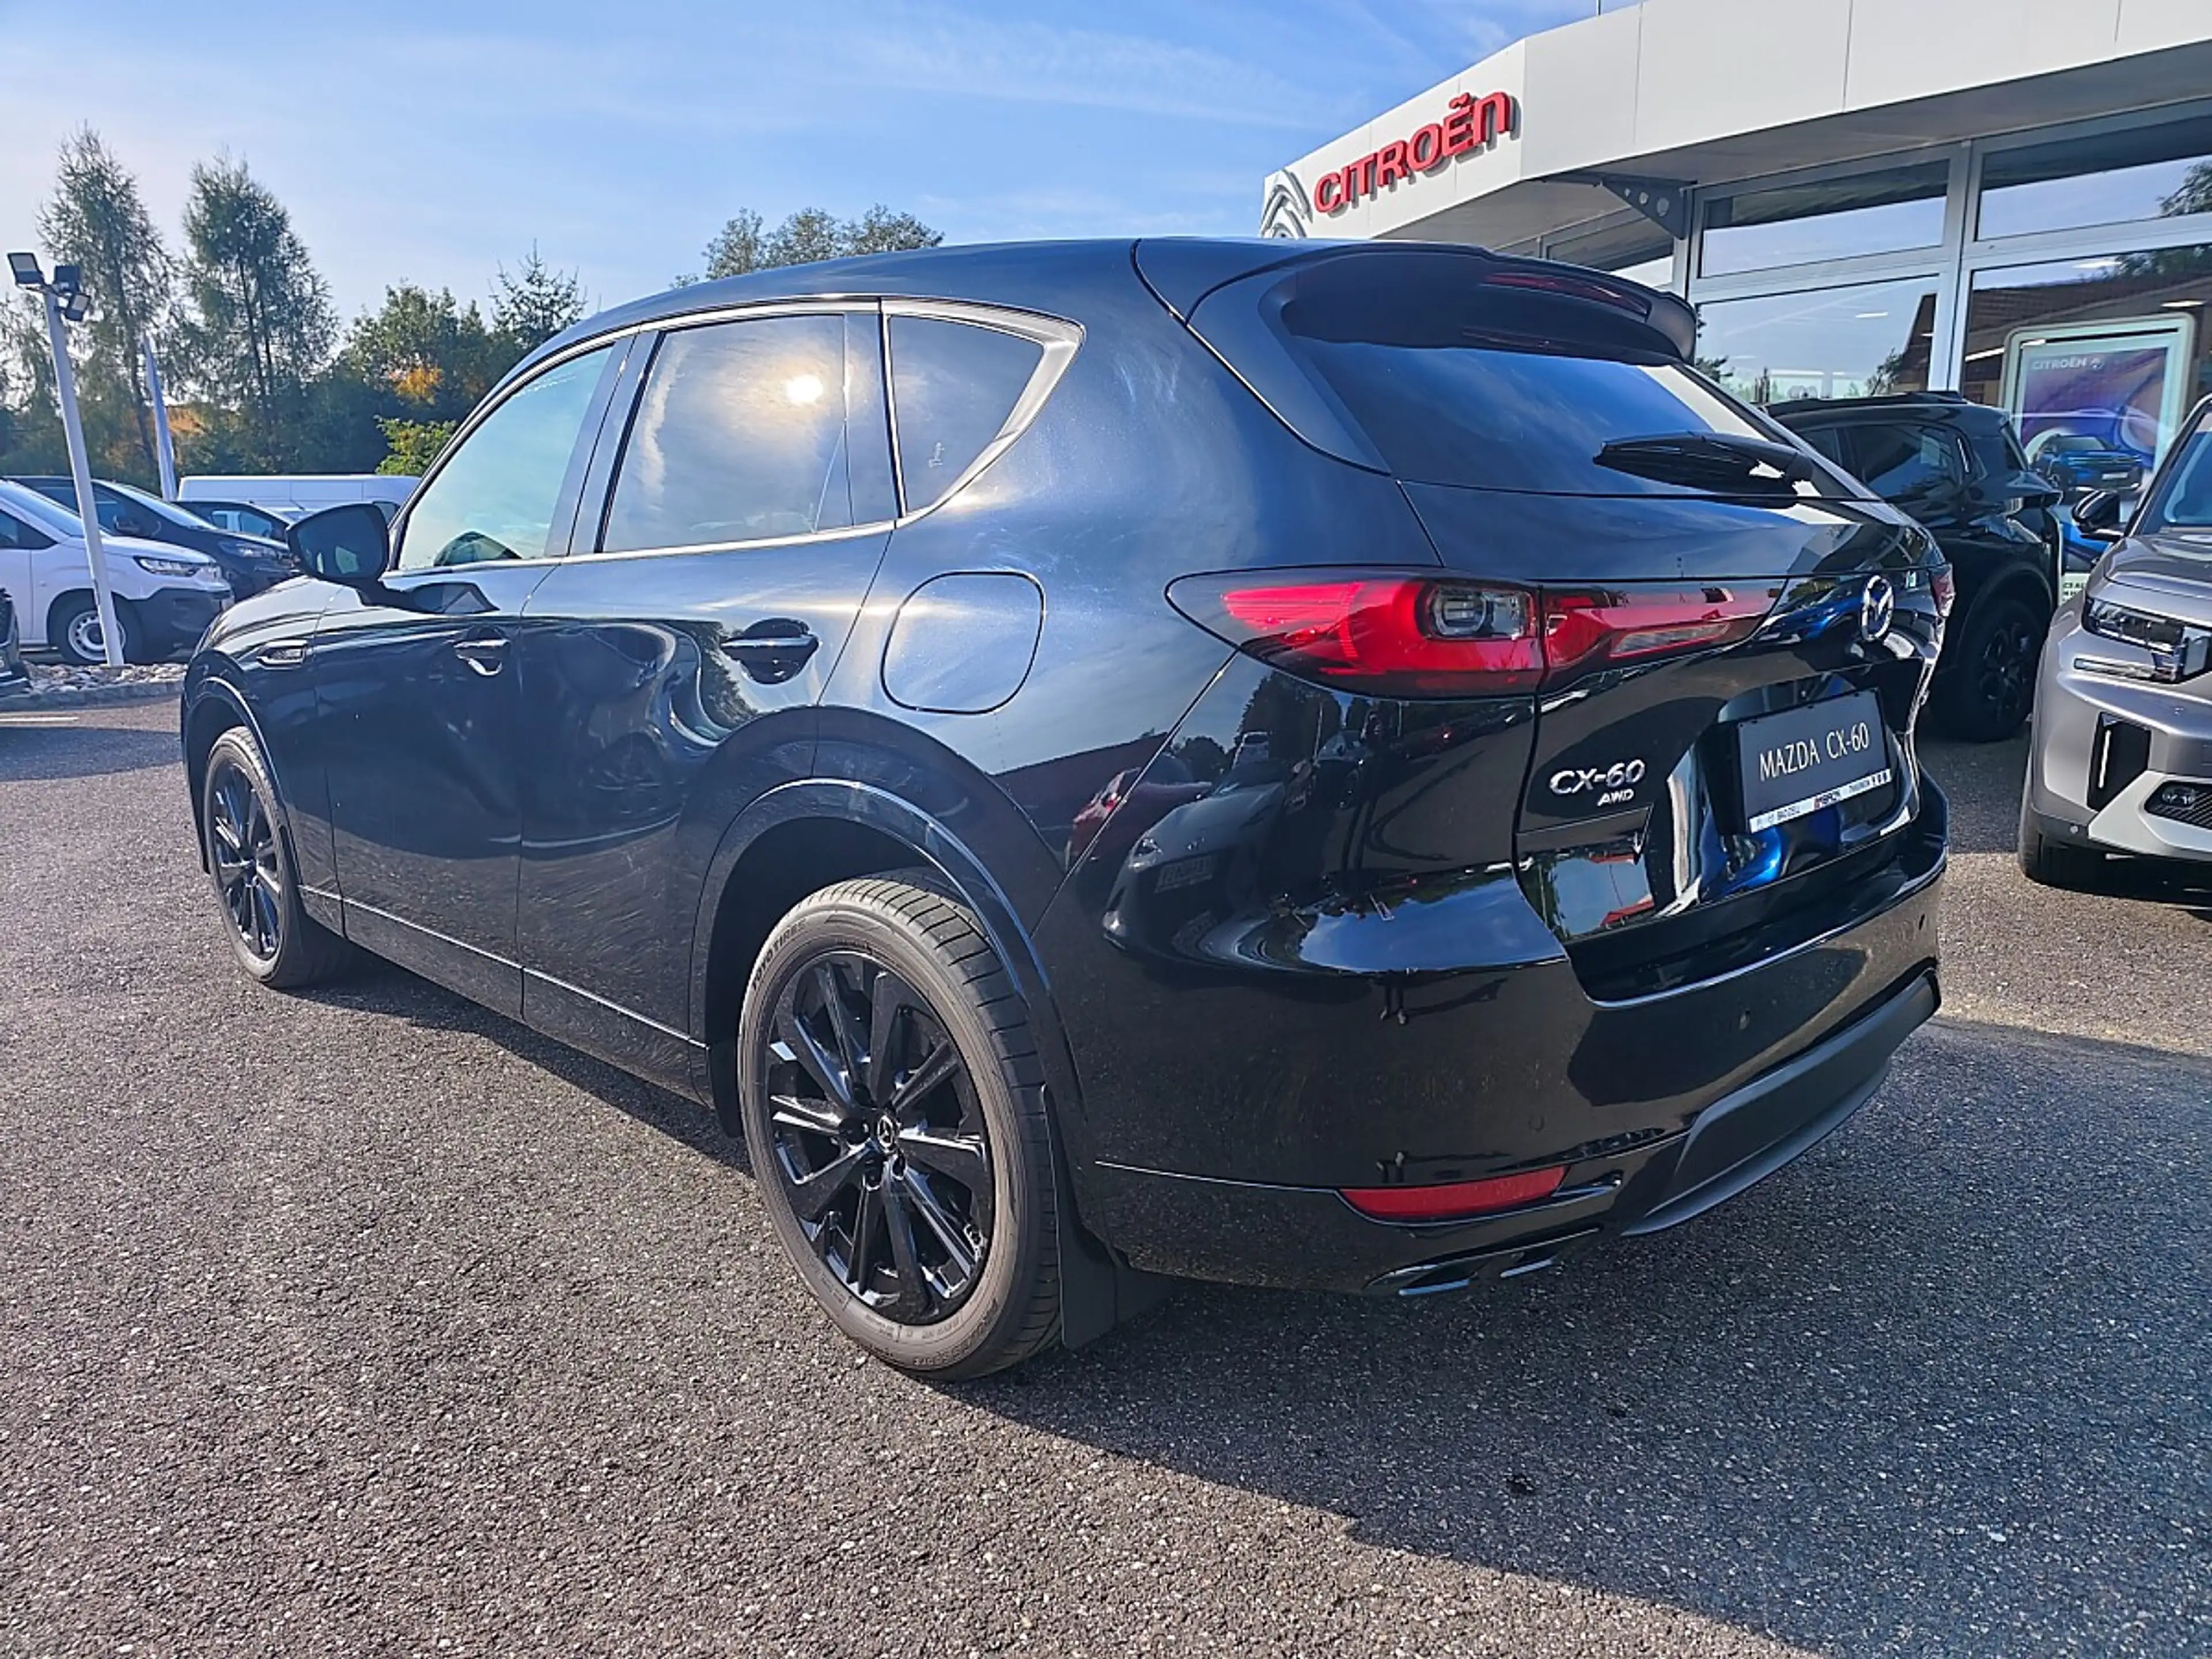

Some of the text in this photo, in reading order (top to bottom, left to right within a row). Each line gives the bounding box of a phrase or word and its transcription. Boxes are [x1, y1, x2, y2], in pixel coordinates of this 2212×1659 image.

[1760, 722, 1870, 782] MAZDA CX-60
[1549, 759, 1646, 794] CX-60
[1597, 788, 1635, 806] AWD
